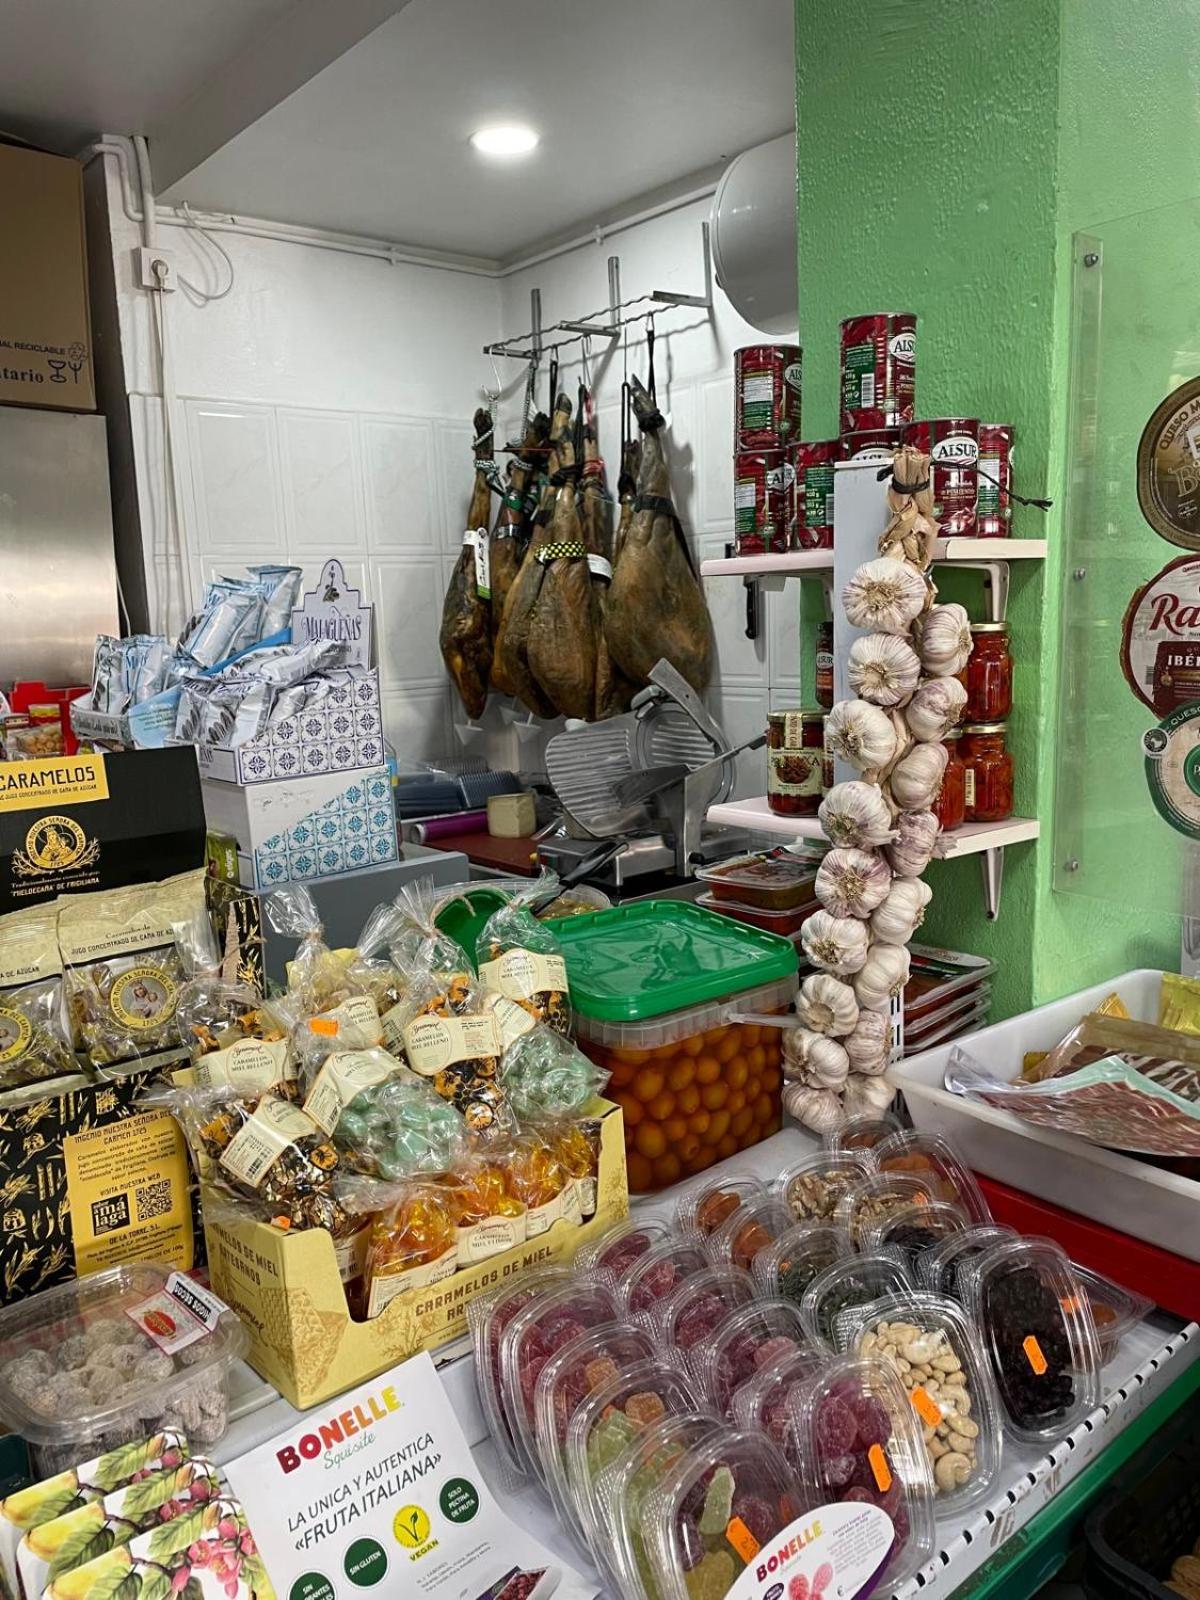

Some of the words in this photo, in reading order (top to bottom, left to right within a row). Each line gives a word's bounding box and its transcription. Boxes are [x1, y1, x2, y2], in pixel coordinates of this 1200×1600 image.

[1159, 410, 1189, 451] QUESO
[938, 443, 977, 459] ALSUR
[88, 937, 129, 953] CONCENTRADO
[131, 935, 139, 943] DE
[103, 1123, 132, 1137] NUESTRA
[103, 1131, 131, 1146] CARMEN
[120, 1177, 146, 1188] NUESTRA
[94, 1209, 128, 1228] laga
[243, 1245, 255, 1263] DE
[255, 1252, 279, 1279] MIEL
[415, 1270, 499, 1317] CARAMELOS
[502, 1258, 519, 1277] DE
[522, 1246, 554, 1269] MIEL
[275, 1385, 402, 1474] BONELLE
[287, 1510, 307, 1532] LA
[308, 1483, 352, 1519] UNICA
[352, 1475, 362, 1491] Y
[364, 1432, 434, 1486] AUTENTICA
[447, 1485, 462, 1499] SOLO
[450, 1509, 459, 1519] DE
[458, 1498, 476, 1514] FRUTA
[409, 1539, 440, 1562] VEGAN
[755, 1519, 824, 1584] BONELLE
[349, 1564, 360, 1576] SIN
[359, 1551, 382, 1569] GLUTEN
[302, 1583, 314, 1595] SIN
